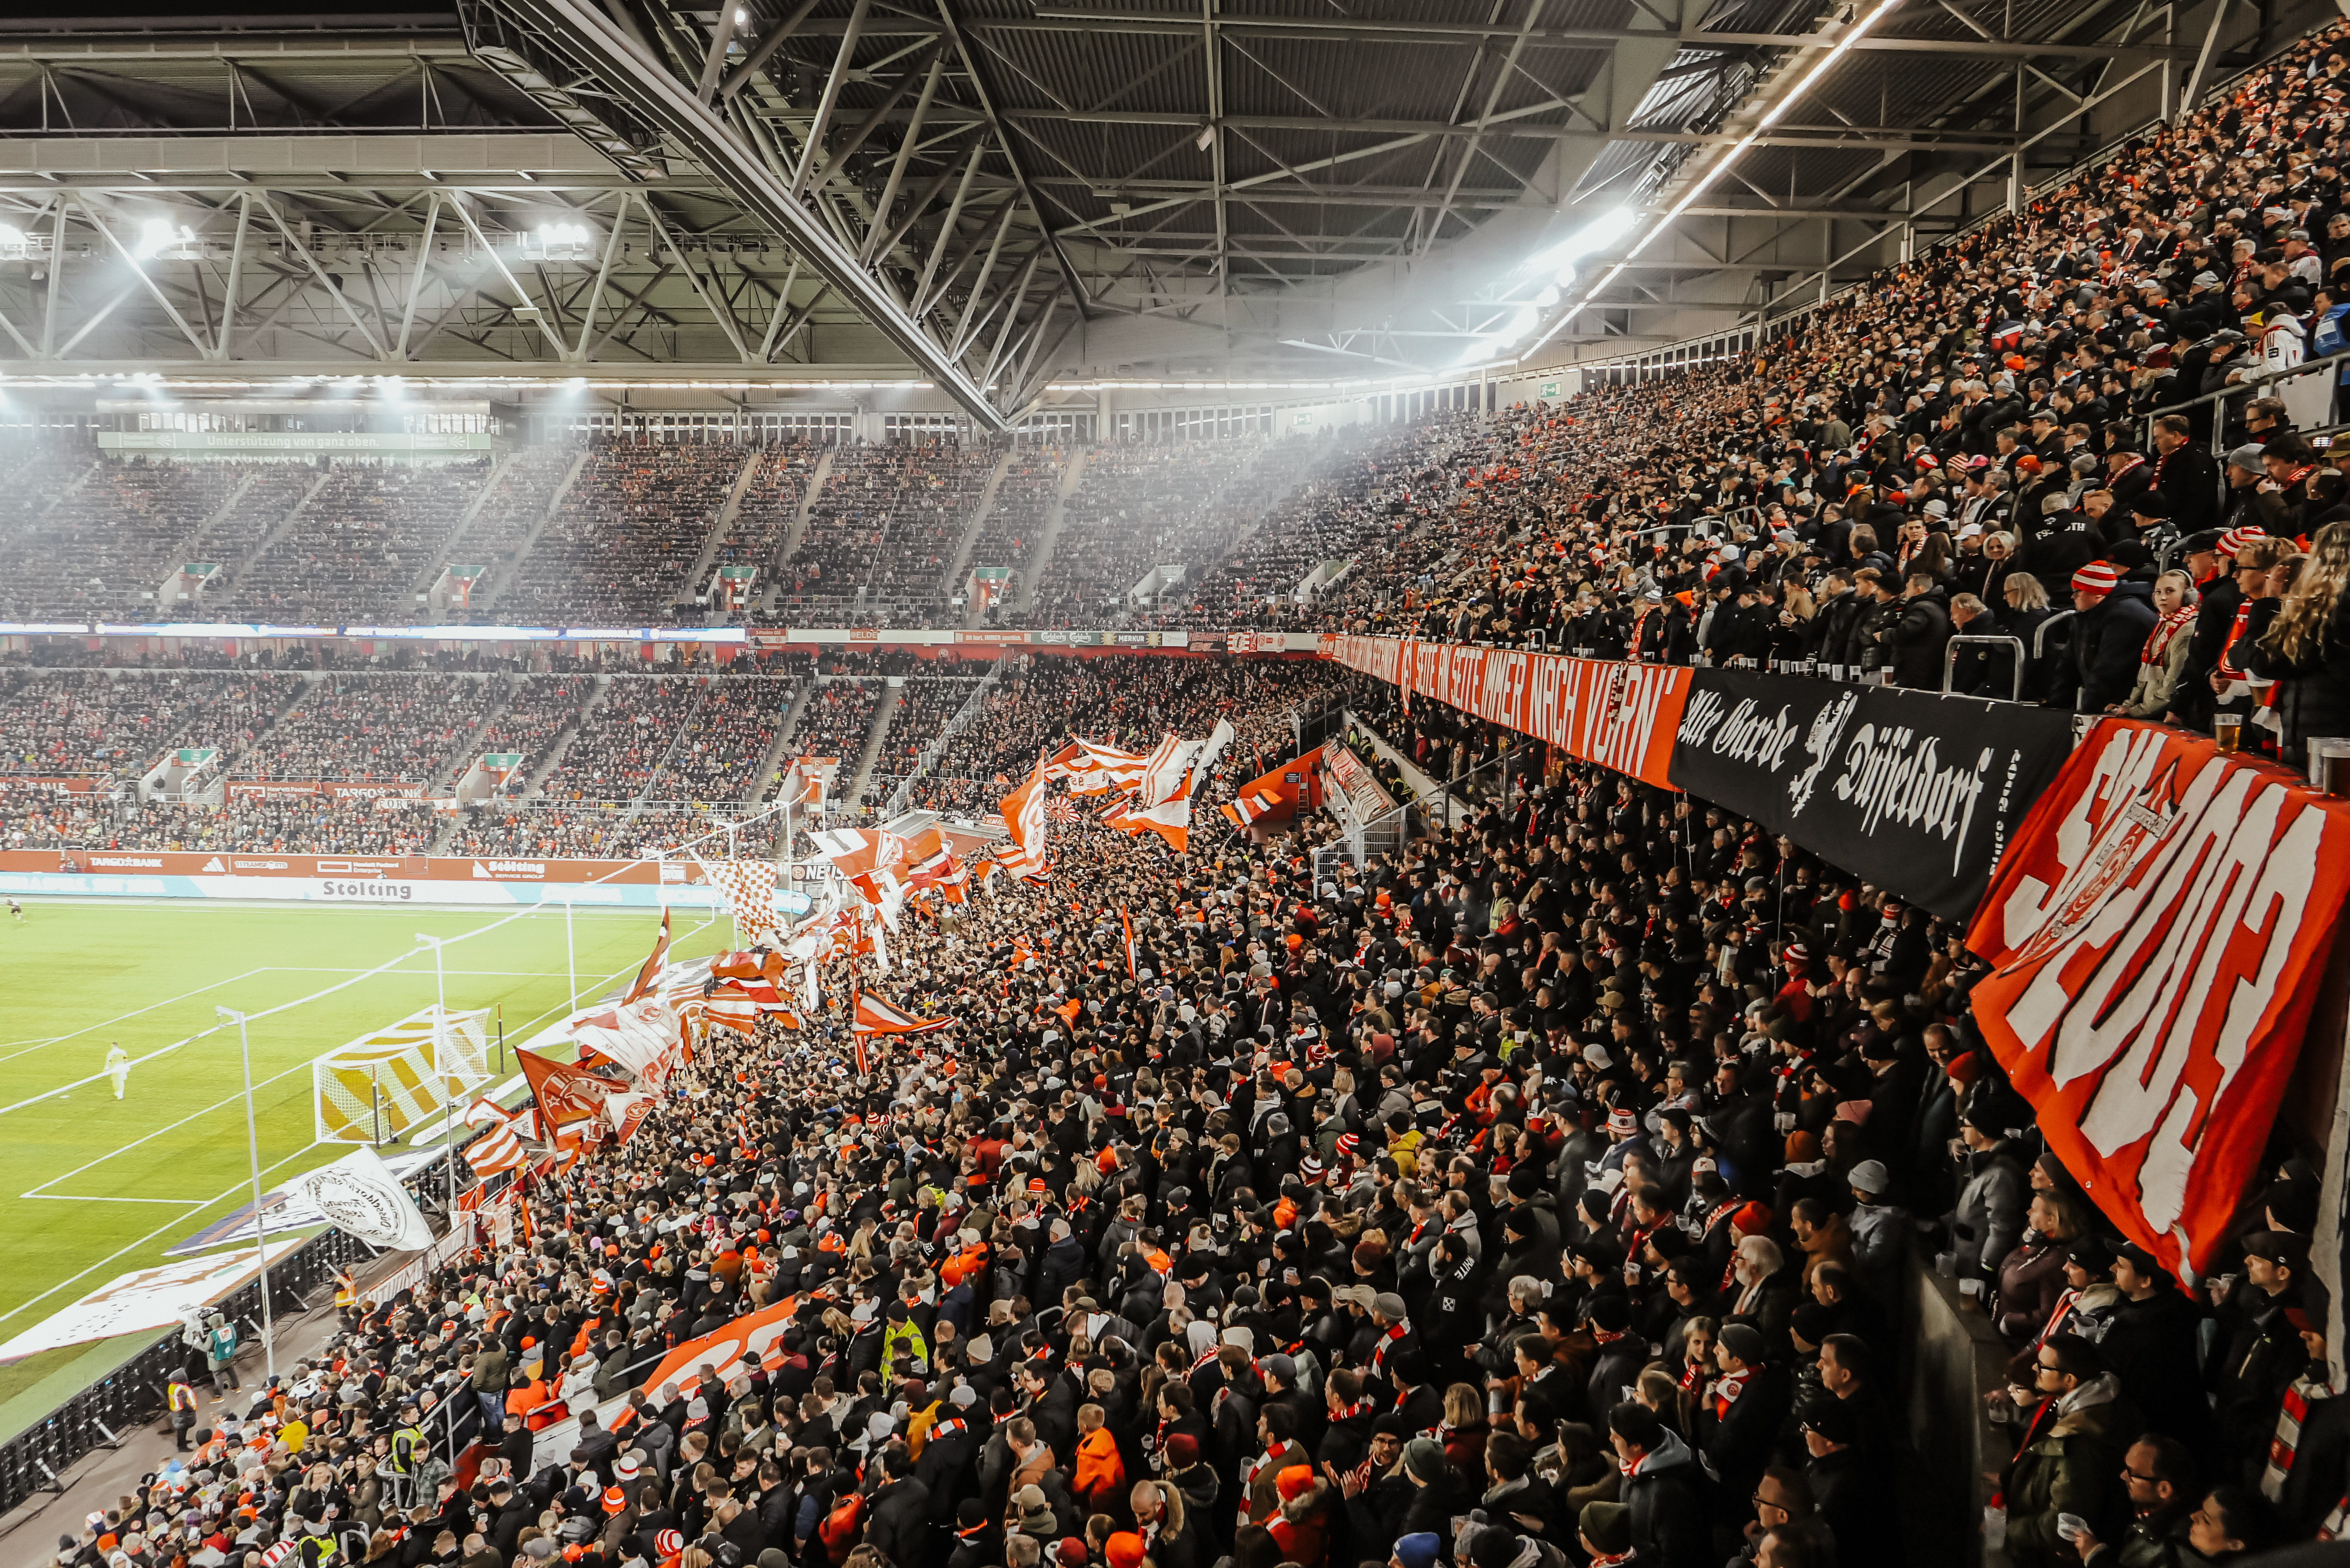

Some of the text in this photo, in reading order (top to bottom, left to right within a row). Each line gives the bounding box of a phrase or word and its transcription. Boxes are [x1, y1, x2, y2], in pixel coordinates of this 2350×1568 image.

[206, 435, 380, 448] Unterstützung von ganz oben.
[1041, 632, 1066, 642] Carlsberg
[1070, 632, 1091, 642] Carlsberg
[1415, 644, 1438, 697] SEITE
[1437, 646, 1453, 702] AN
[1451, 647, 1483, 715] SEITE
[1481, 651, 1527, 730] IMMER
[1529, 655, 1582, 752] NACH
[1677, 689, 1994, 877] Alte Garde Düsseldorf
[488, 861, 545, 874] Stölting
[324, 881, 412, 899] Stölting
[1453, 1254, 1475, 1281] WHITE
